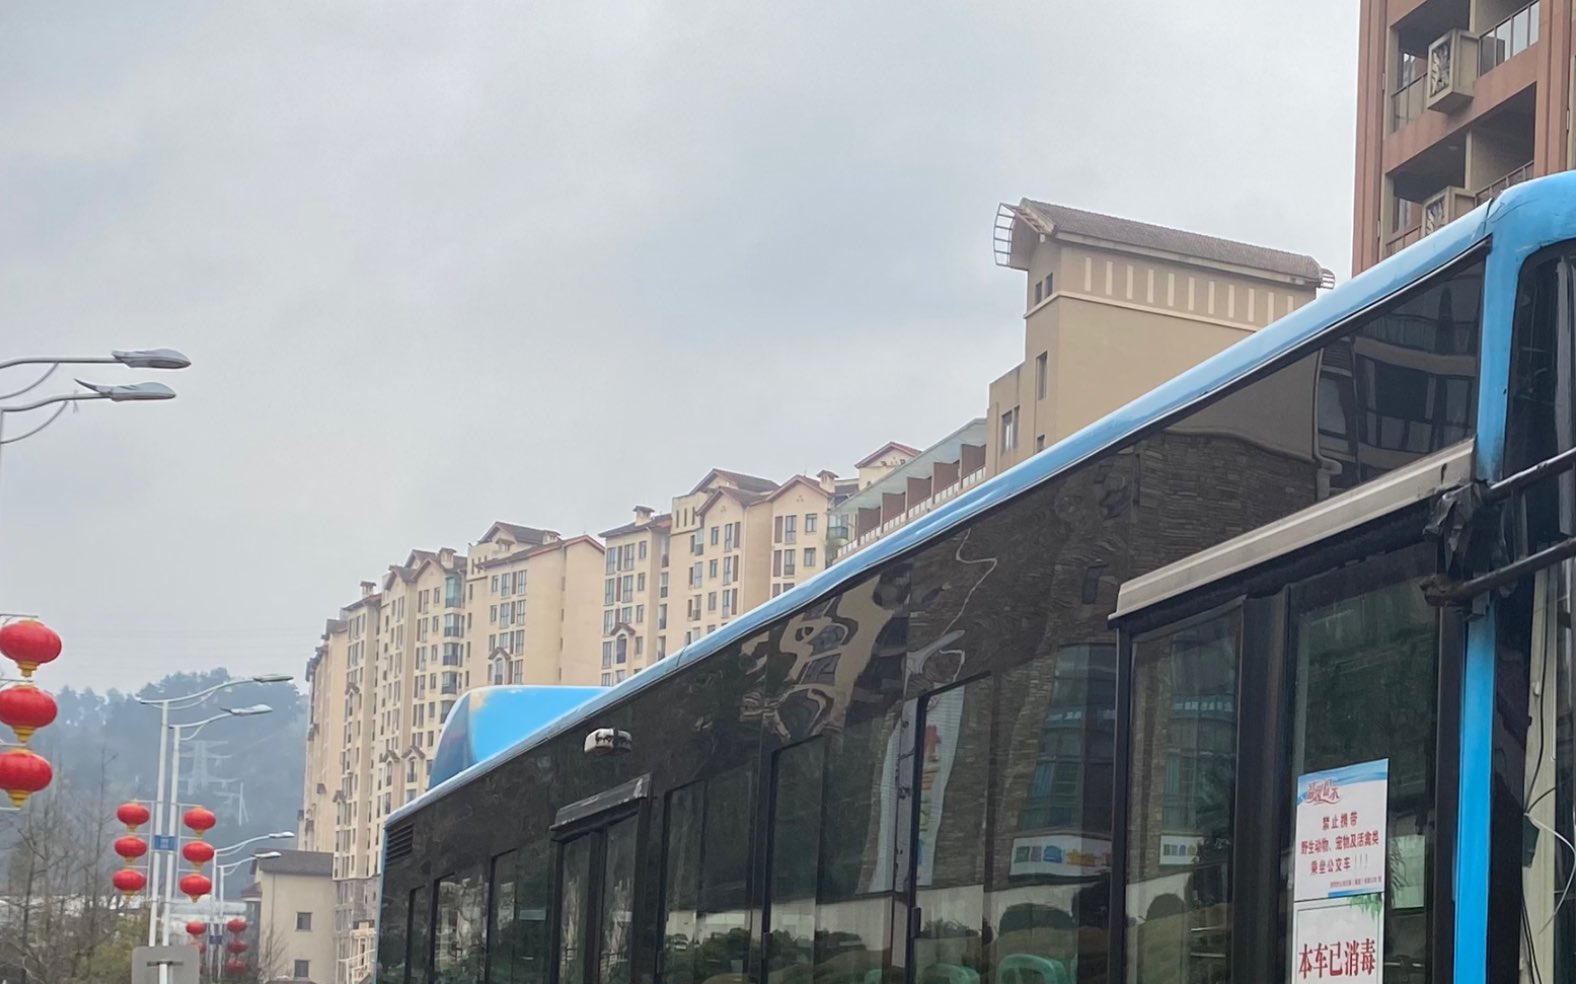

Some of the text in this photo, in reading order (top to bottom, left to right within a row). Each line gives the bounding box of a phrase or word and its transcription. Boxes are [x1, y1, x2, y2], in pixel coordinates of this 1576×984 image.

[1298, 938, 1377, 980] 本车已消毒
